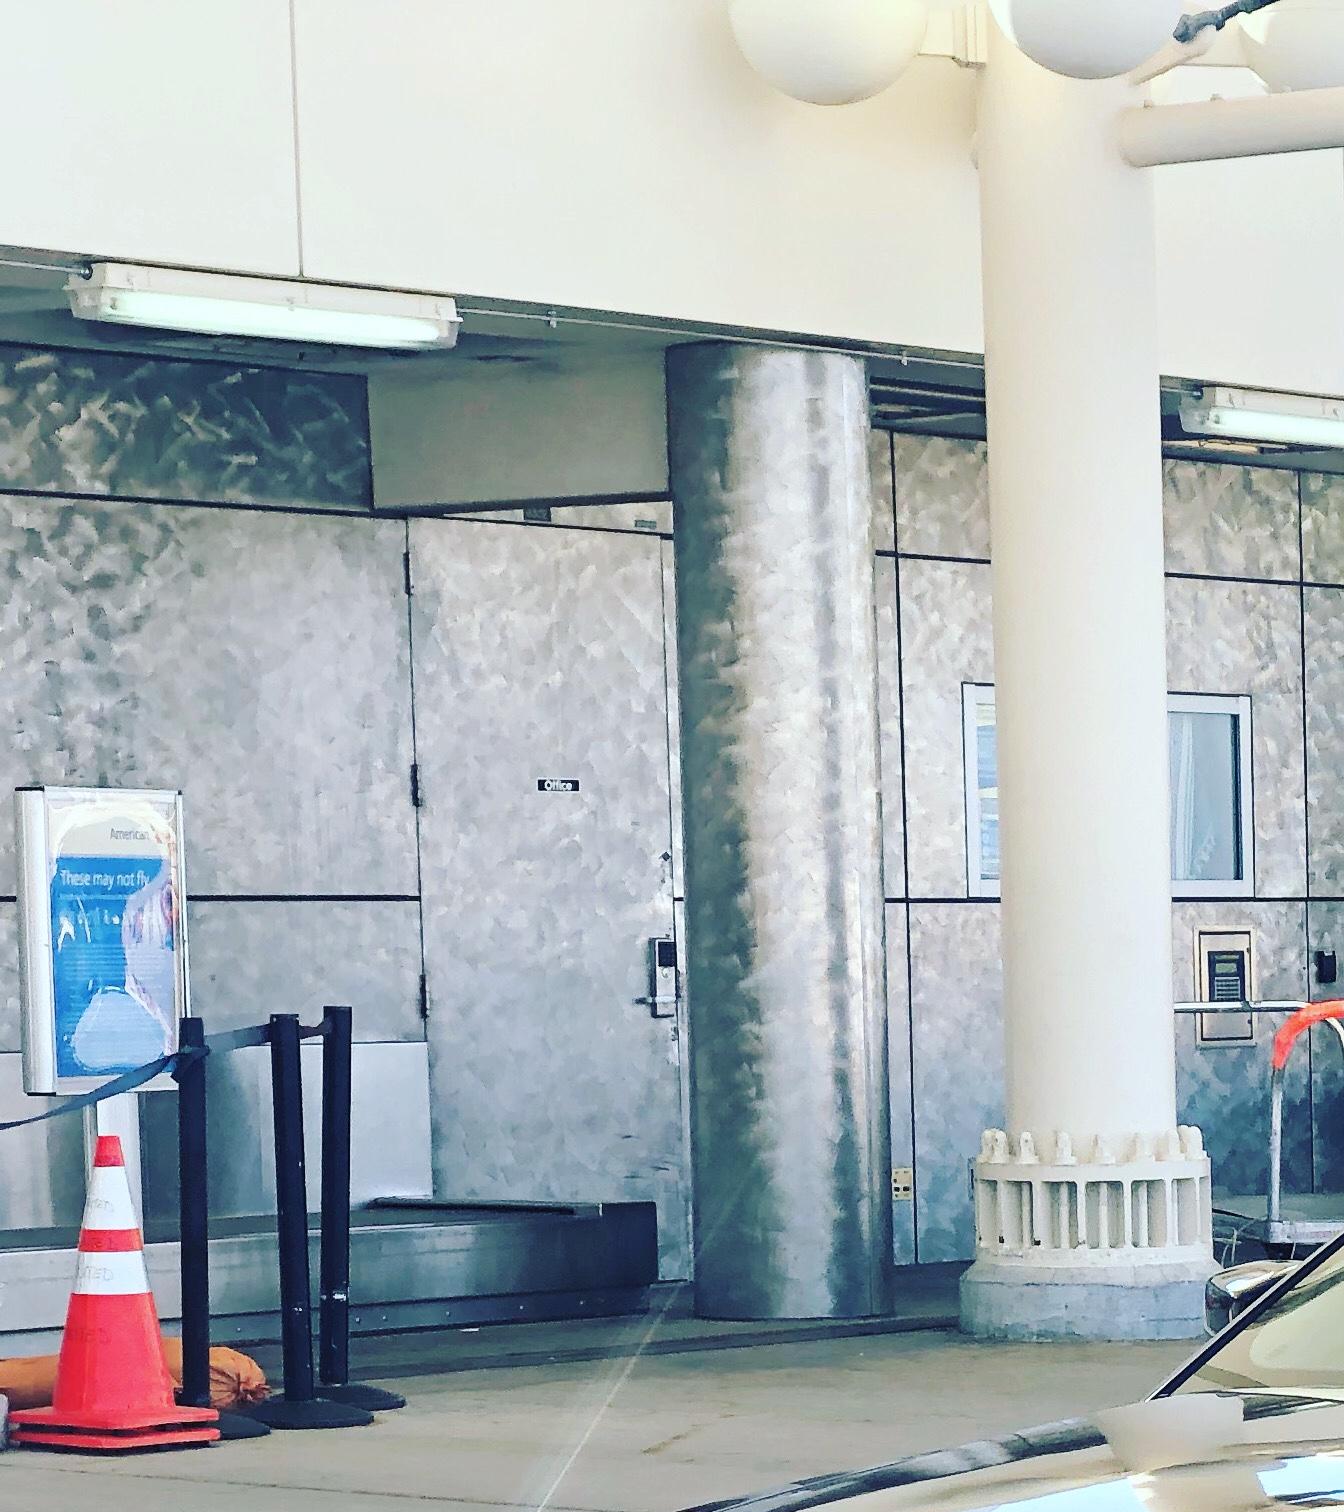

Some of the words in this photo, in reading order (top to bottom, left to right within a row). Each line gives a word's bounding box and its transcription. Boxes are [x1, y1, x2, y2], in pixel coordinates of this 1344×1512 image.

[544, 780, 573, 791] Office
[110, 828, 149, 841] American
[60, 869, 91, 886] These
[93, 873, 115, 891] may
[117, 872, 134, 887] not
